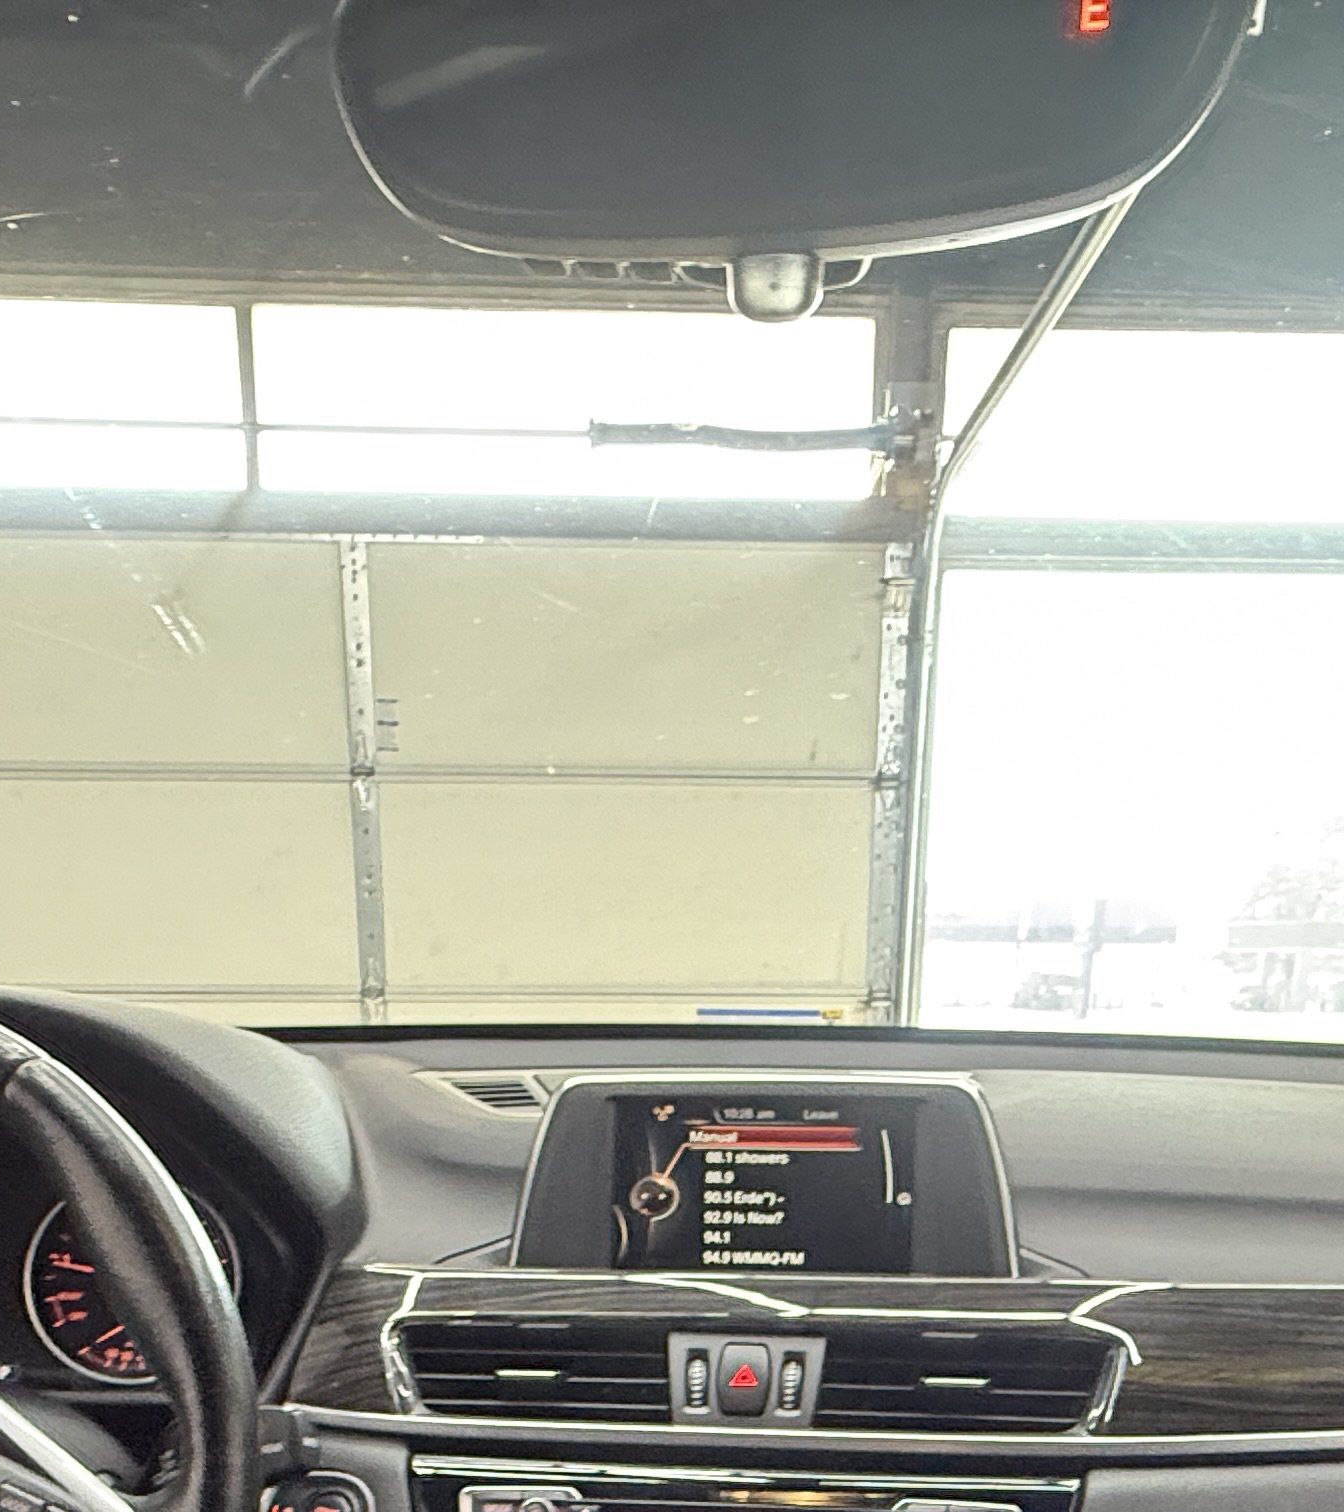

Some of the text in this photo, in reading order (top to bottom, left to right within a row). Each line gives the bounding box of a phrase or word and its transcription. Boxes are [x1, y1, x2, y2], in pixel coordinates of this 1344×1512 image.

[689, 1130, 738, 1143] Manual
[703, 1211, 732, 1224] 92.9
[703, 1230, 731, 1244] 94.1
[702, 1250, 731, 1265] 94.9
